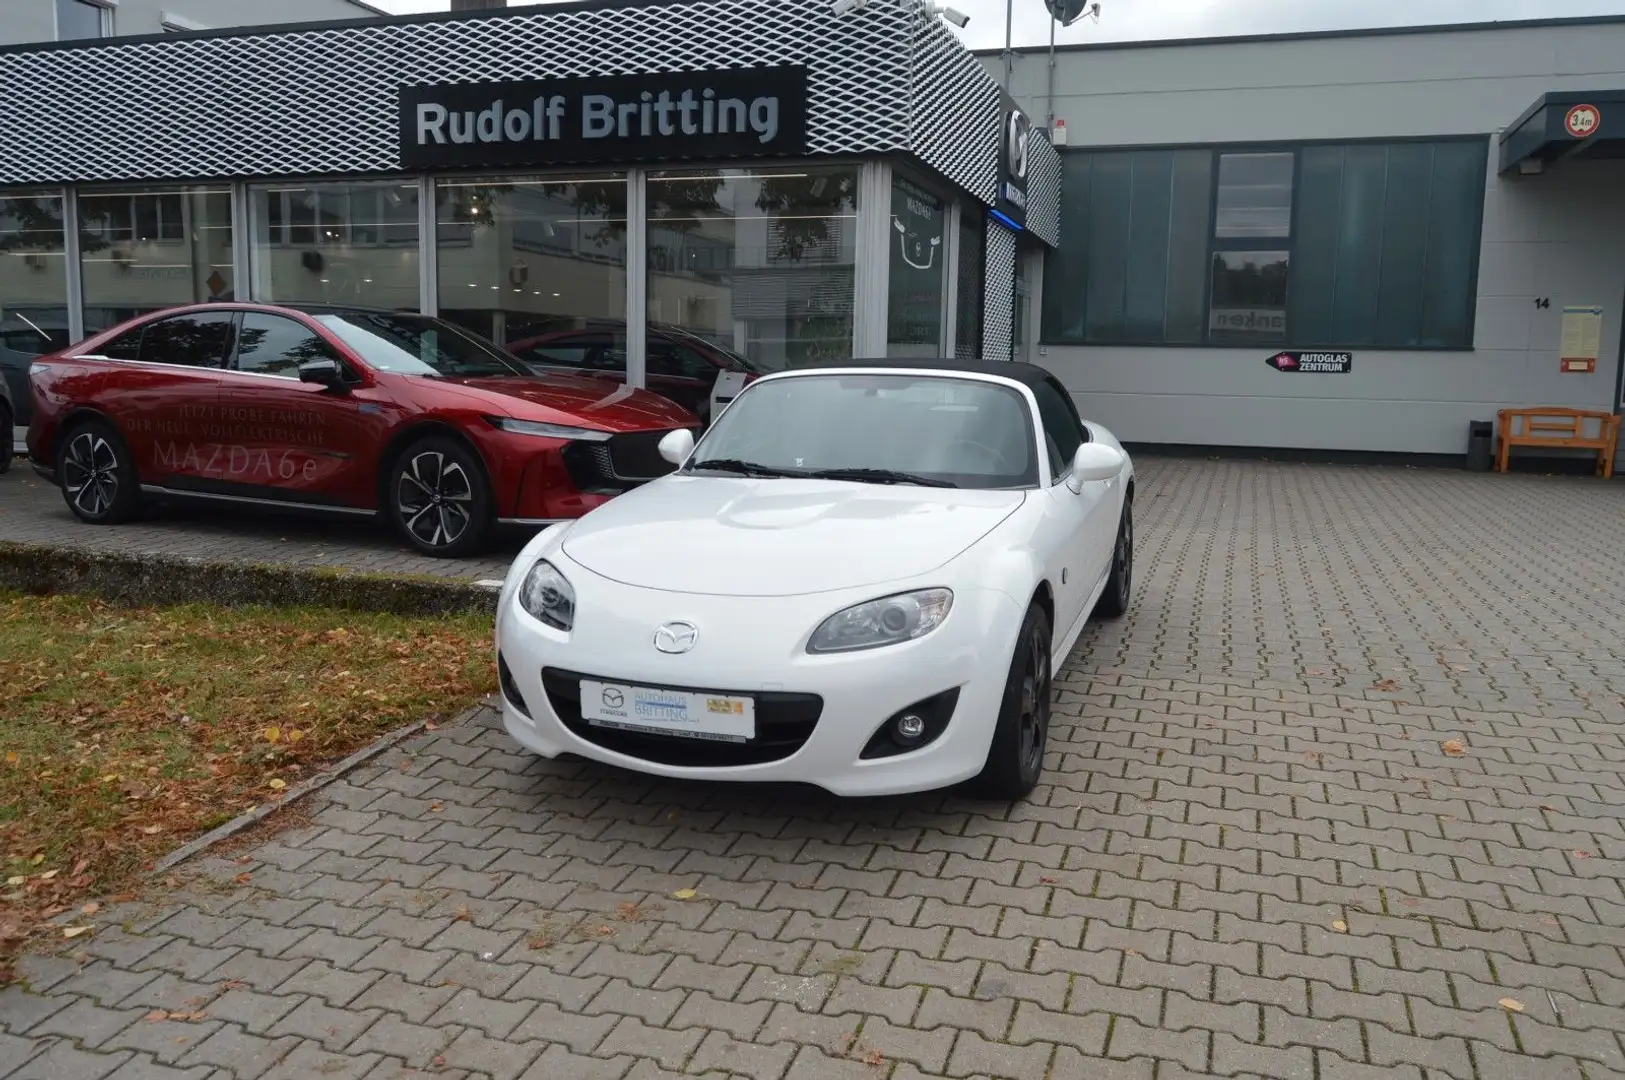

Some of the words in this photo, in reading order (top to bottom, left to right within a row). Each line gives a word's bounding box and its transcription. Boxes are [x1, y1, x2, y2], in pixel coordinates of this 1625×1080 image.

[416, 95, 566, 145] Rudolf
[581, 87, 779, 144] Britting
[1535, 297, 1549, 310] 14
[1300, 353, 1348, 363] AUTOGLAS
[1299, 362, 1343, 372] ZENTRUM
[221, 406, 265, 422] PROBE
[153, 439, 317, 481] MAZDA6e
[634, 704, 689, 721] BRITTING
